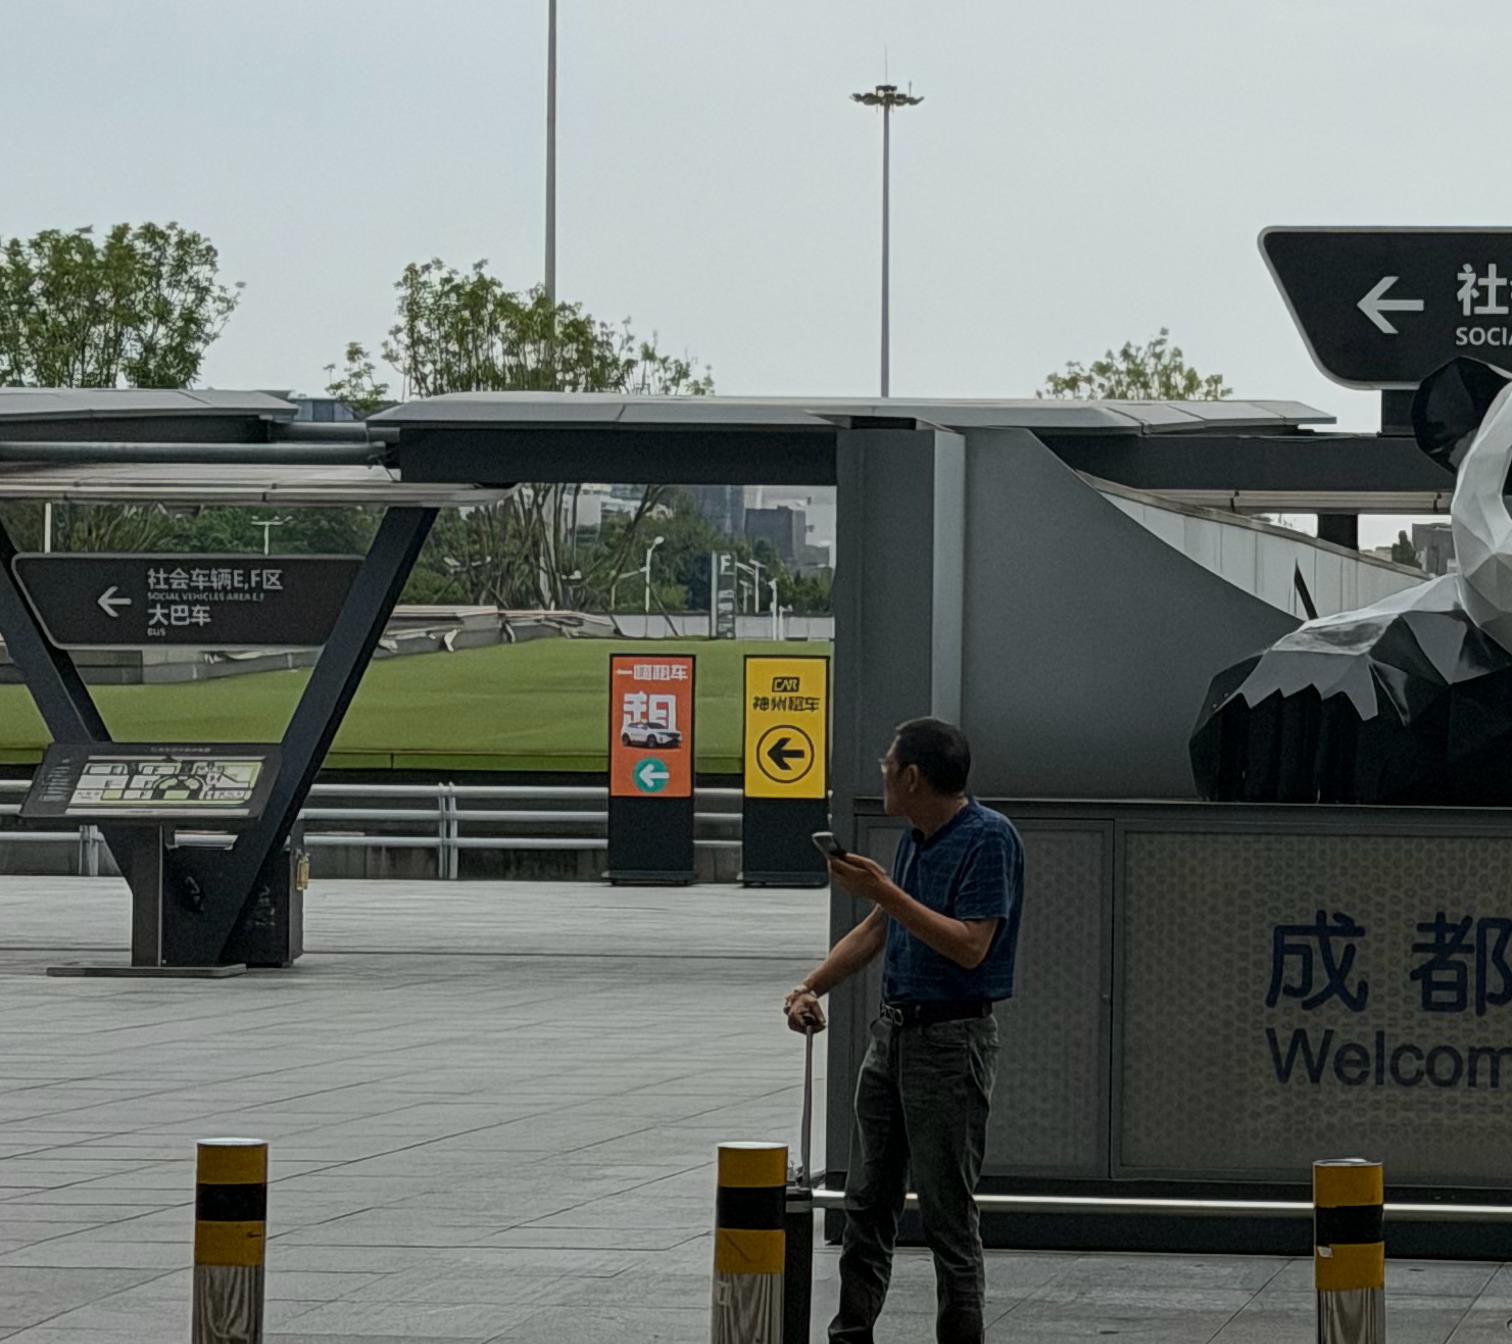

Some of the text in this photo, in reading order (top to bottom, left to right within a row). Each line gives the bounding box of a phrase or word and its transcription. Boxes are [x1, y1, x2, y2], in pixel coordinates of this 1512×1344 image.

[147, 568, 283, 590] 社会车辆E,F区
[147, 603, 212, 627] 大巴车
[774, 679, 798, 691] CAR
